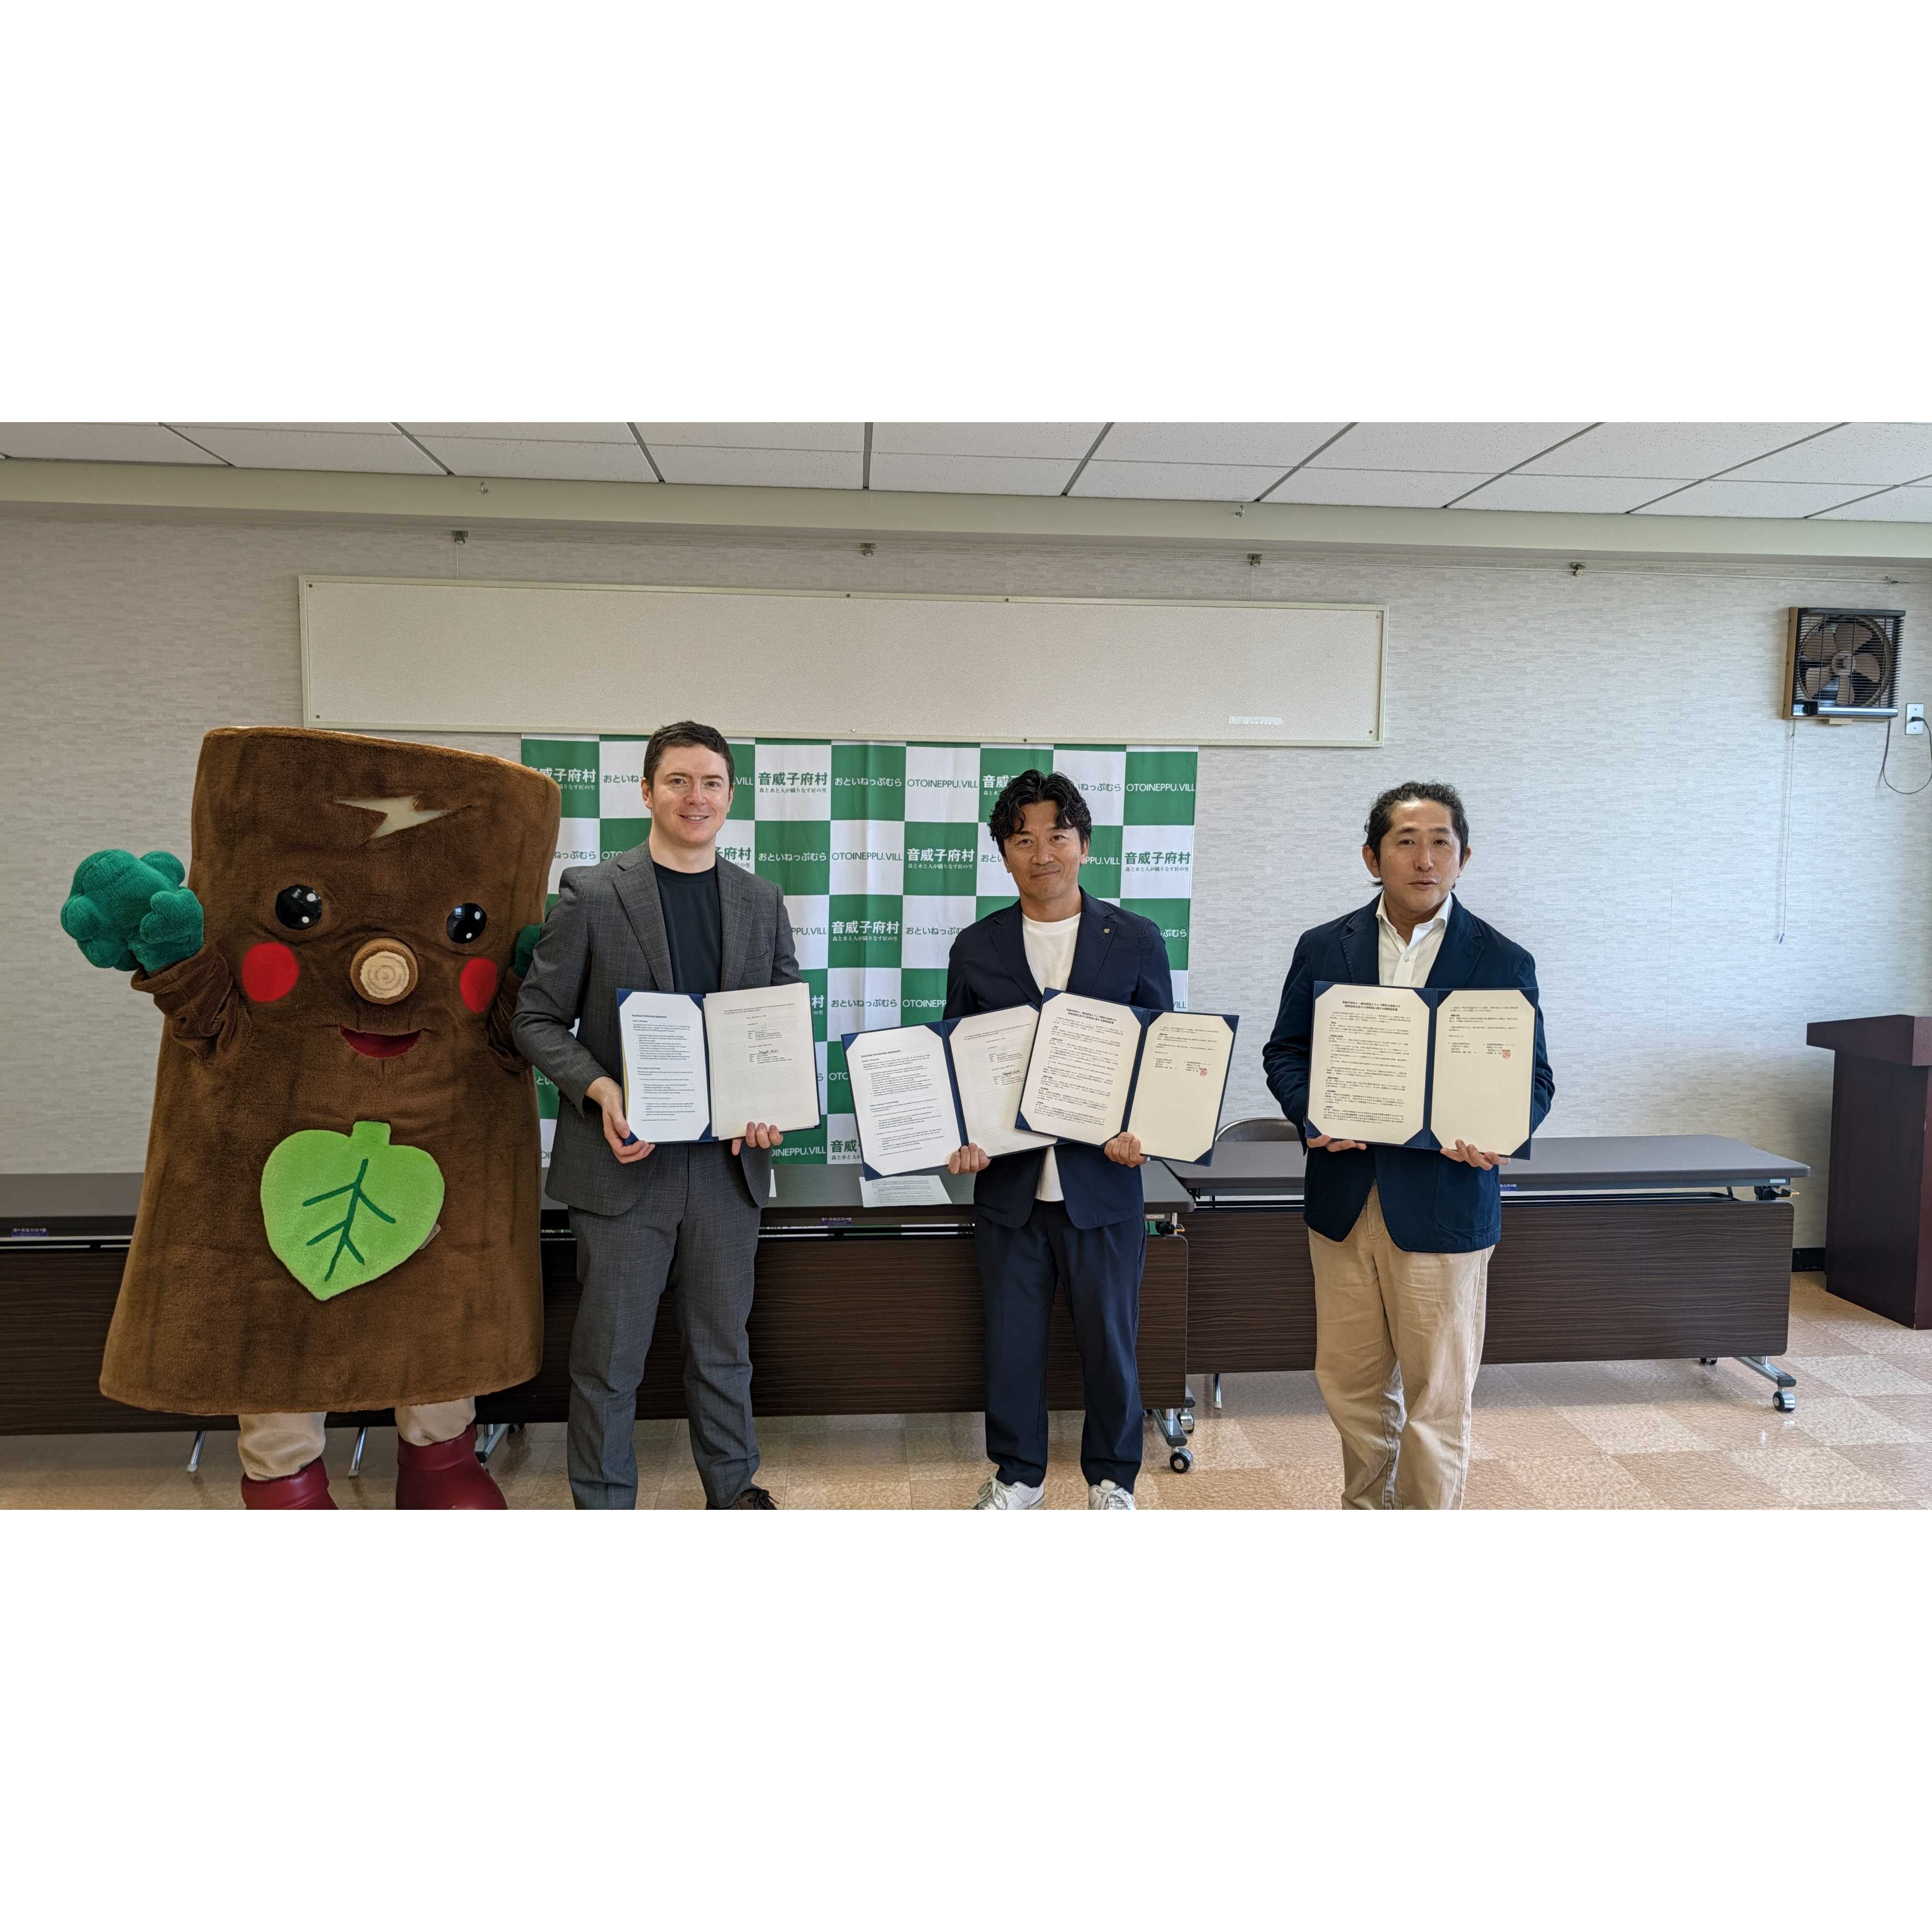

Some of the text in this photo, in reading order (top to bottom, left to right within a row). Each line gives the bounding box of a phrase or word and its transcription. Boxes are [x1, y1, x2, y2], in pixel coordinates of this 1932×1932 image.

[603, 774, 643, 783] おといね
[758, 772, 828, 786] 音威子府村
[835, 777, 902, 787] おといねっぷむら
[907, 779, 978, 788] OTOINEPPU.VILL
[982, 774, 1021, 788] 音威
[1126, 782, 1196, 792] OTOINEPPU.VILL
[759, 852, 827, 862] おといねっぷむら
[831, 852, 903, 862] OTOINEPPU.VILL
[907, 848, 975, 862] 音威子府村
[1125, 851, 1191, 865] 音威子府村
[831, 920, 900, 934] 音威子府村
[811, 995, 825, 1009] 村
[831, 999, 897, 1008] おといねっぷむら
[830, 1139, 860, 1153] 音威
